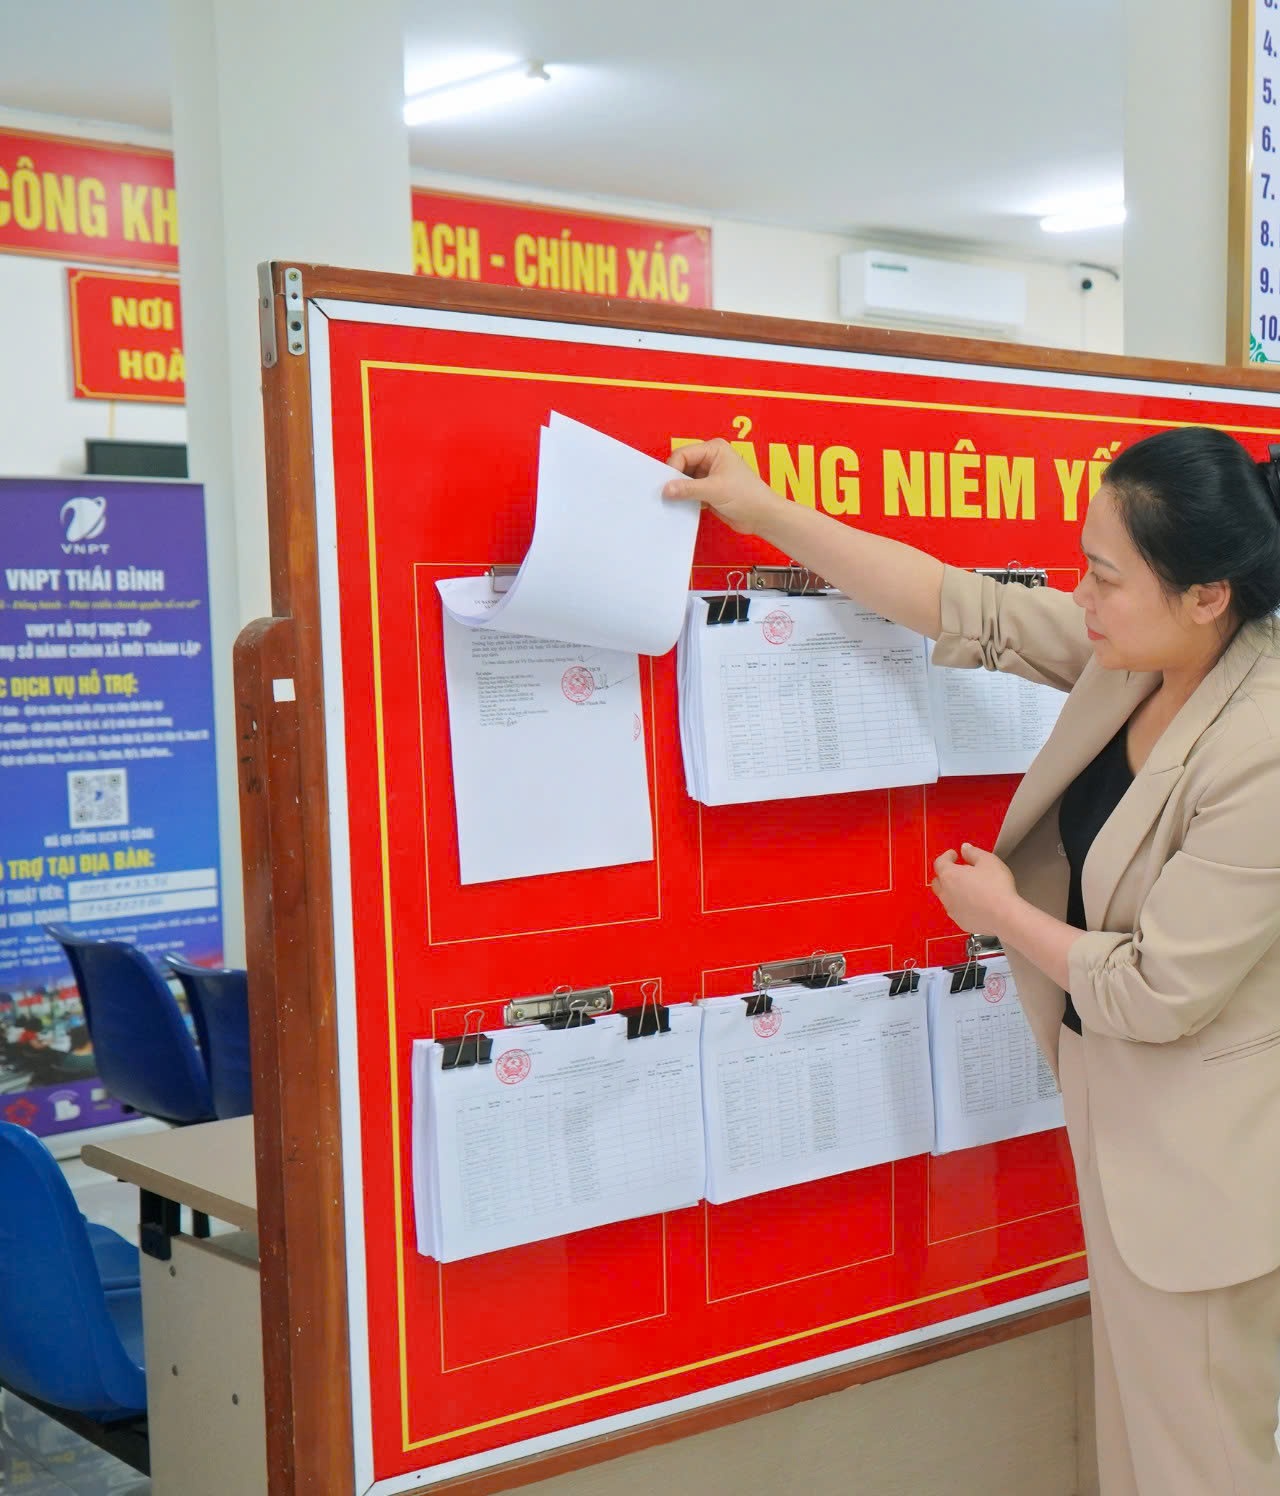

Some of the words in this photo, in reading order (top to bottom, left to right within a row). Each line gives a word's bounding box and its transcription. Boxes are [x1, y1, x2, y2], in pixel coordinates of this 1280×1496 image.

[1263, 30, 1277, 57] 4.
[1262, 77, 1277, 105] 5.
[1261, 125, 1276, 153] 6.
[1261, 173, 1275, 200] 7.
[1260, 220, 1274, 247] 8.
[514, 229, 618, 297] CHÍNH
[626, 241, 690, 303] XÁC
[1260, 267, 1273, 294] 9.
[111, 296, 174, 331] NƠI
[1259, 314, 1280, 341] 10.
[671, 415, 861, 516] ẢNG
[883, 438, 1036, 521] NIÊM
[61, 543, 110, 555] VNPT
[5, 567, 61, 591] VNPT
[64, 564, 111, 591] THÁI
[115, 565, 165, 591] BÌNH
[10, 676, 50, 701] DỊCH
[53, 675, 75, 699] VỤ
[104, 672, 139, 698] TRỢ:
[8, 857, 44, 882] TRỢ
[47, 855, 75, 880] TẠI
[79, 852, 110, 876] ĐỊA
[114, 847, 155, 870] BÀN:
